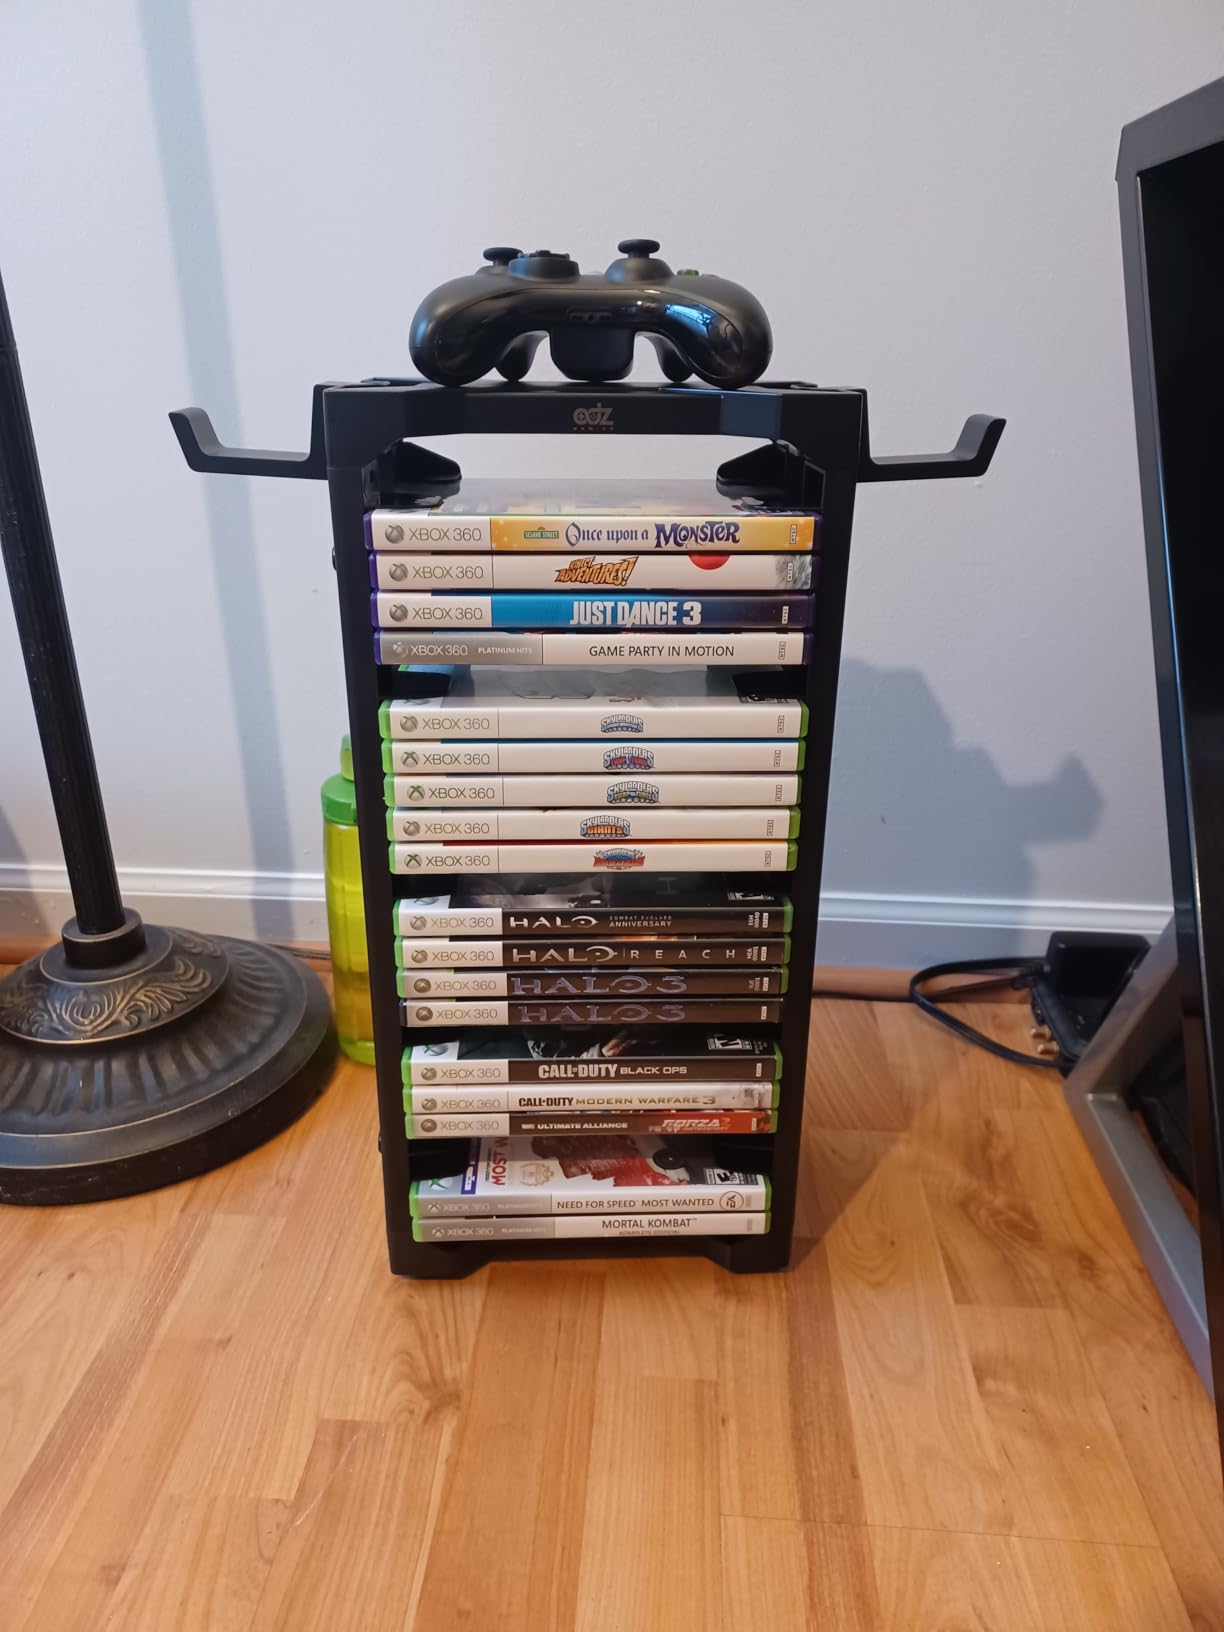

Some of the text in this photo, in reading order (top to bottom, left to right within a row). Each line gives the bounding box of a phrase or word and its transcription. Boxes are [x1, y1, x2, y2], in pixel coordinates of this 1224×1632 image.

[409, 528, 482, 541] XBOX 360
[565, 522, 602, 546] Once
[606, 529, 638, 543] upon
[641, 529, 649, 540] a
[412, 566, 484, 579] XBOX 360
[554, 556, 639, 587] ADVENTURES!
[412, 607, 483, 620] XBOX 360
[569, 601, 702, 627] JUST DANCE 3
[411, 645, 468, 656] XBOX 360
[589, 645, 735, 657] GAME PARTY IN MOTION
[422, 718, 490, 730] XBOX 360
[423, 753, 490, 765] XBOX 360
[603, 746, 654, 769] SKYLANDERS
[429, 787, 495, 799] XBOX 360
[607, 781, 659, 803] SKYLANDERS
[424, 822, 490, 834] XBOX 360
[580, 815, 631, 837] SKYLANDERS
[425, 855, 490, 867] XBOX 360
[431, 917, 494, 928] XBOX 360
[509, 915, 599, 928] HALO
[432, 950, 495, 961] XBOX 360
[512, 945, 736, 962] HALO REACH
[434, 980, 497, 991] XBOX 360
[511, 975, 688, 994] HALO 3
[436, 1008, 498, 1019] XBOX 360
[517, 1004, 686, 1022] HALO 3
[441, 1067, 500, 1078] XBOX 360
[620, 1066, 660, 1074] BLACK
[663, 1066, 688, 1074] OPS
[442, 1098, 500, 1109] XBOX 360
[576, 1097, 633, 1105] MODERN
[638, 1096, 699, 1105] WARFARE
[702, 1096, 716, 1105] 3
[440, 1120, 499, 1130] XBOX 360
[661, 1117, 731, 1128] FORZA 2
[491, 1150, 507, 1186] MOST
[557, 1198, 714, 1209] NEED FOR SPEED MOST WANTED
[602, 1220, 645, 1229] MORTAL
